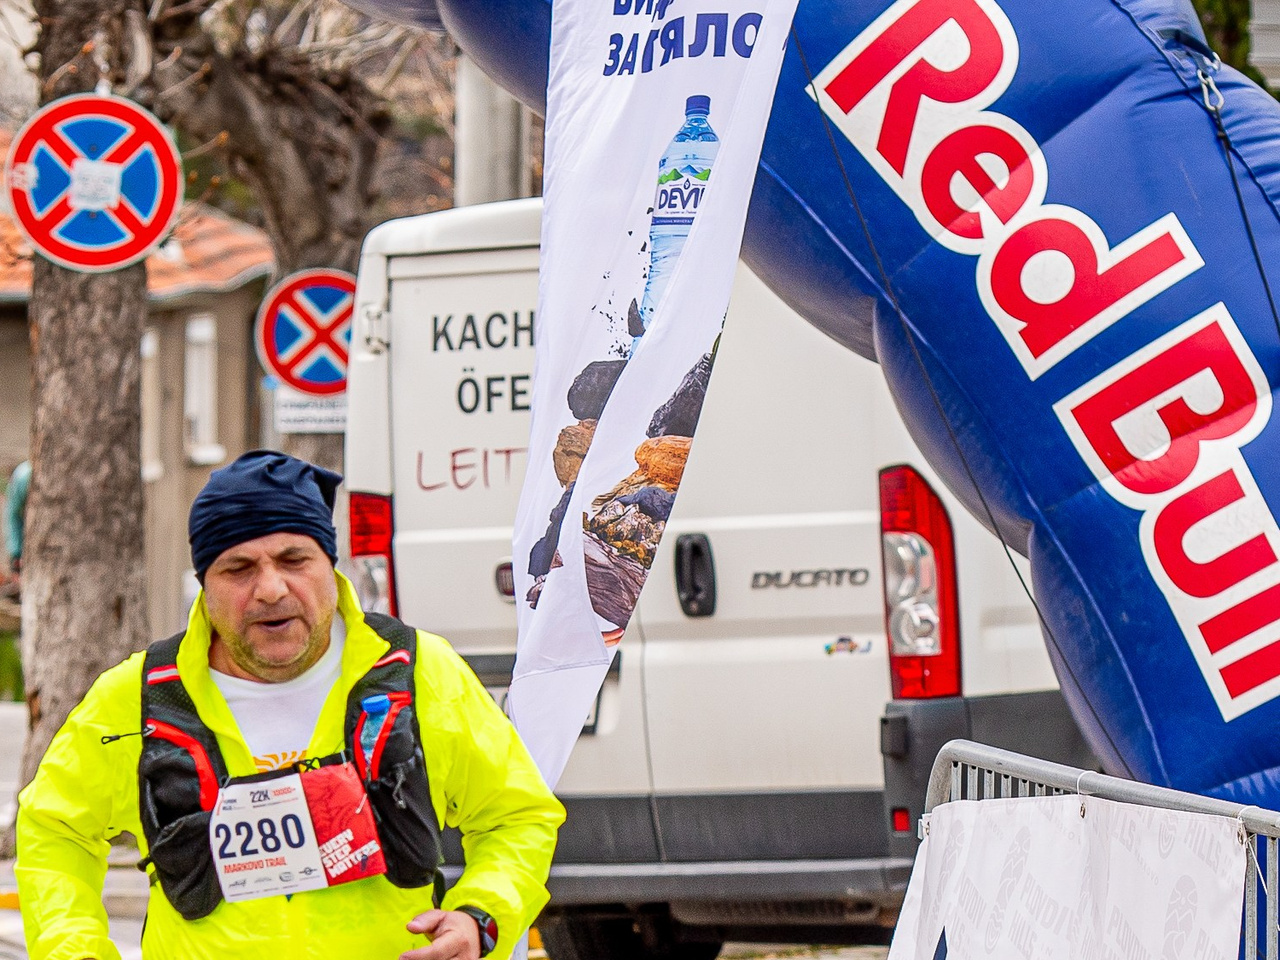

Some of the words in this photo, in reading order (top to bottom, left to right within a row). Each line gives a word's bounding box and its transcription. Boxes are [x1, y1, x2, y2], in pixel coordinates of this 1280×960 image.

[658, 187, 705, 209] DEVI
[432, 311, 536, 352] KACH
[824, 0, 1185, 360] Red
[1072, 320, 1280, 699] Bull
[457, 367, 531, 414] ÖFE
[416, 447, 529, 491] LEIT
[751, 569, 870, 589] DUCATO
[215, 813, 305, 859] 2280
